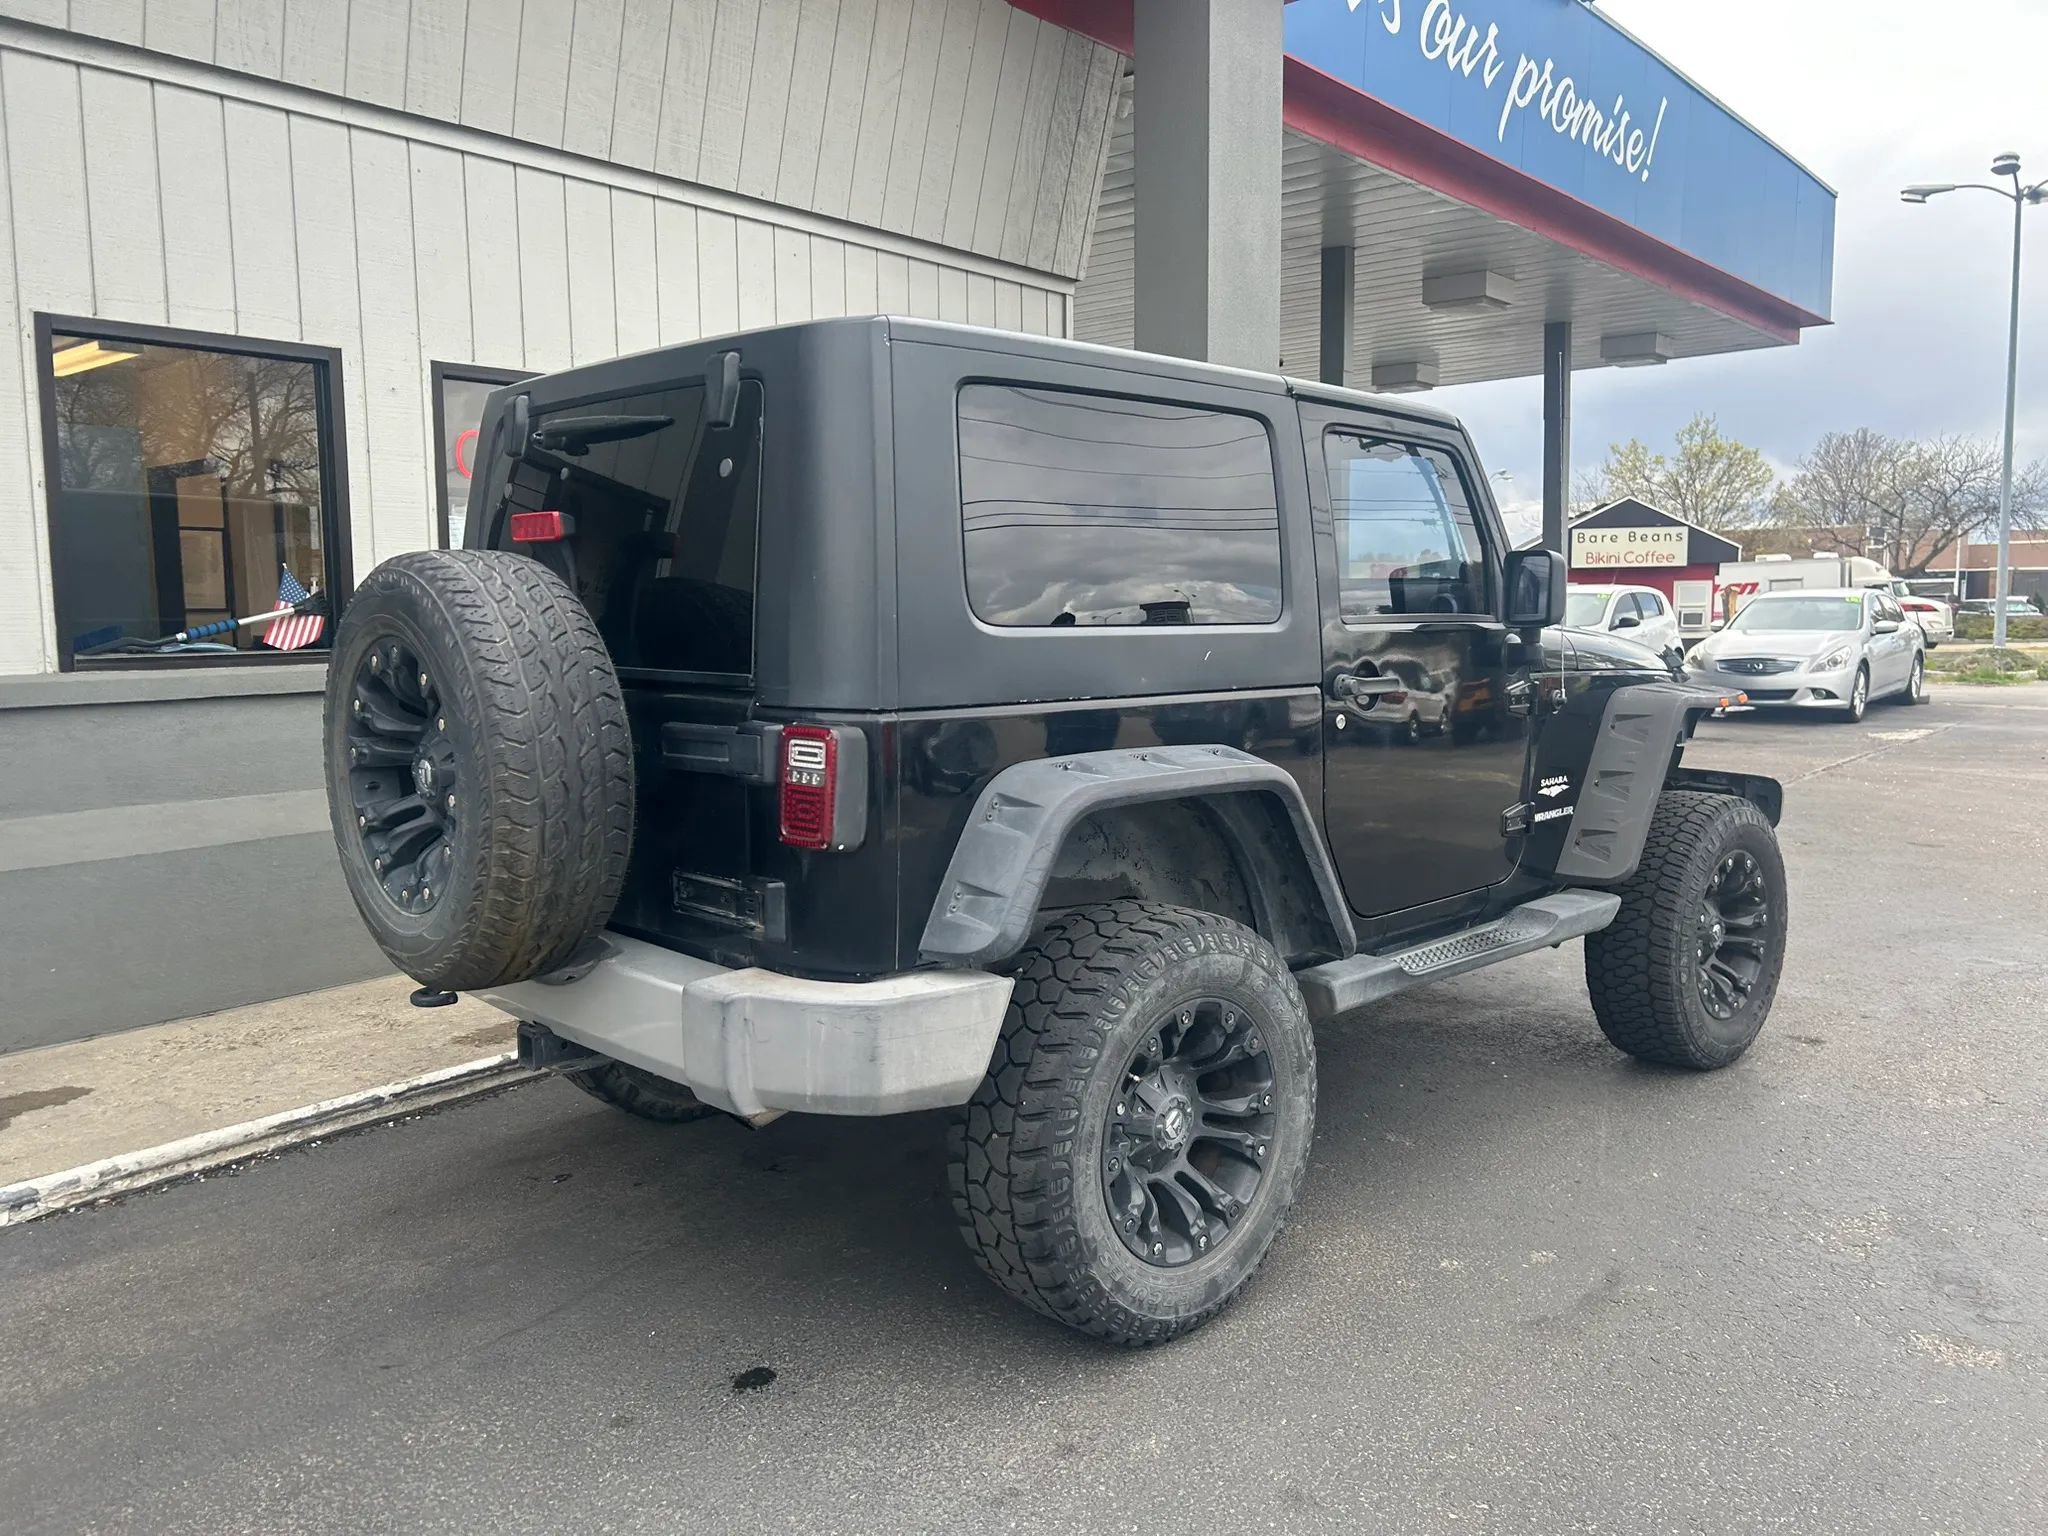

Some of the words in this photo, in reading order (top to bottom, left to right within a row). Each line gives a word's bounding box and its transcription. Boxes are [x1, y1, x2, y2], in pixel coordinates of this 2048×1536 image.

[1420, 0, 1504, 88] our
[1498, 54, 1667, 182] promise!
[1577, 532, 1618, 544] Bare
[1628, 531, 1683, 542] Beans
[1585, 551, 1620, 564] Bikini
[1623, 550, 1675, 564] Coffee
[1540, 775, 1568, 787] SAHARA
[1534, 805, 1574, 822] WRANGLER
